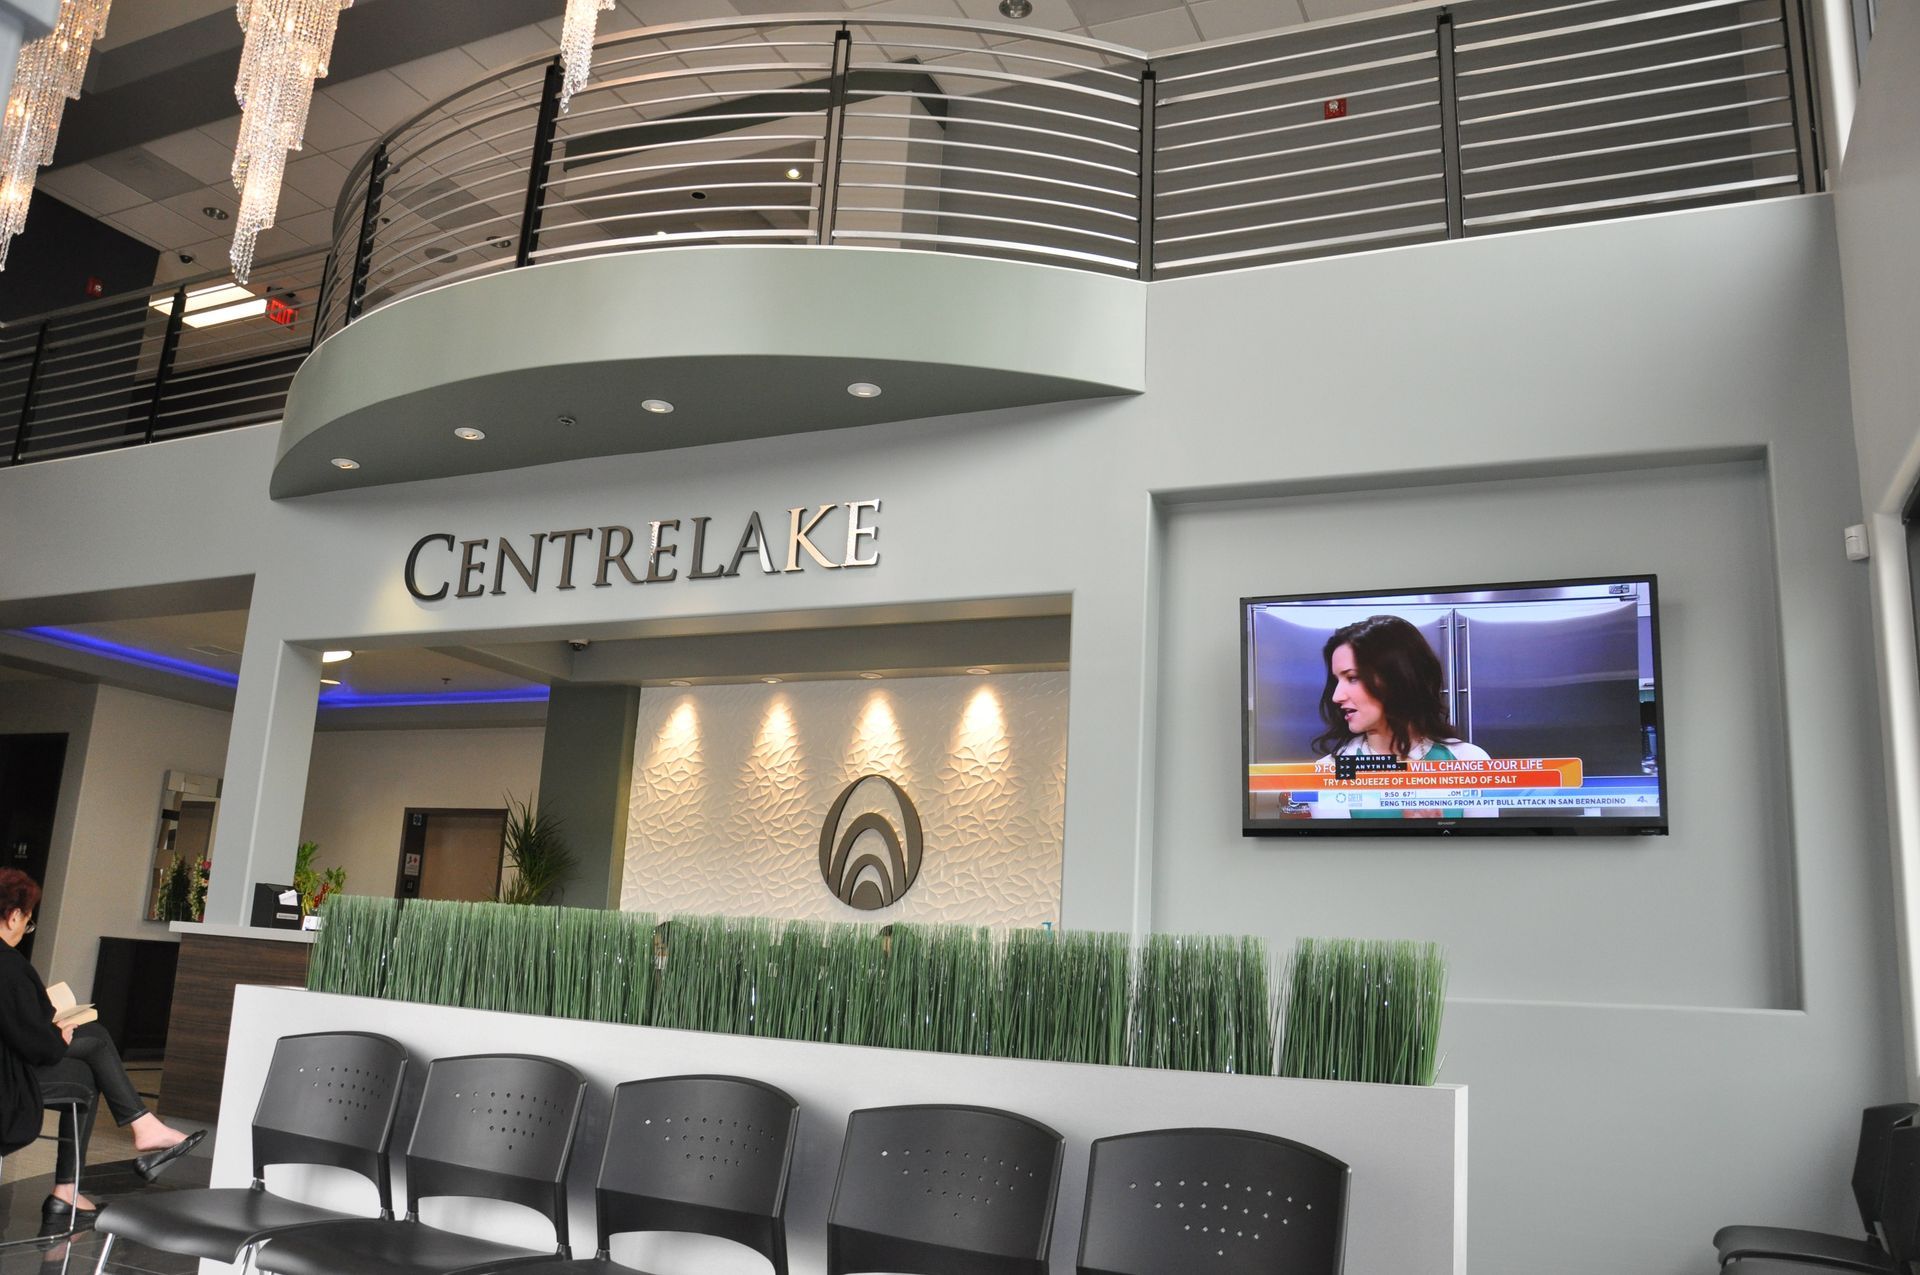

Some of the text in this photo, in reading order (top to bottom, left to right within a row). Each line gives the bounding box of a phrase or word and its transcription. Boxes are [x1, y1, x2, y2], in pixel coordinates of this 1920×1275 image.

[270, 299, 295, 325] EXIT
[404, 498, 881, 602] CENTRELAKE
[1409, 760, 1543, 772] WILL CHANGE YOUR LIFE
[1323, 778, 1339, 787] TRY
[1350, 778, 1390, 786] SQUEEZE
[1391, 777, 1404, 786] OF
[1406, 777, 1437, 785] LEMON
[1439, 776, 1478, 785] INSTEAD
[1480, 775, 1493, 784] OF
[1494, 775, 1517, 784] SALT
[1575, 797, 1626, 805] BERNARDINO
